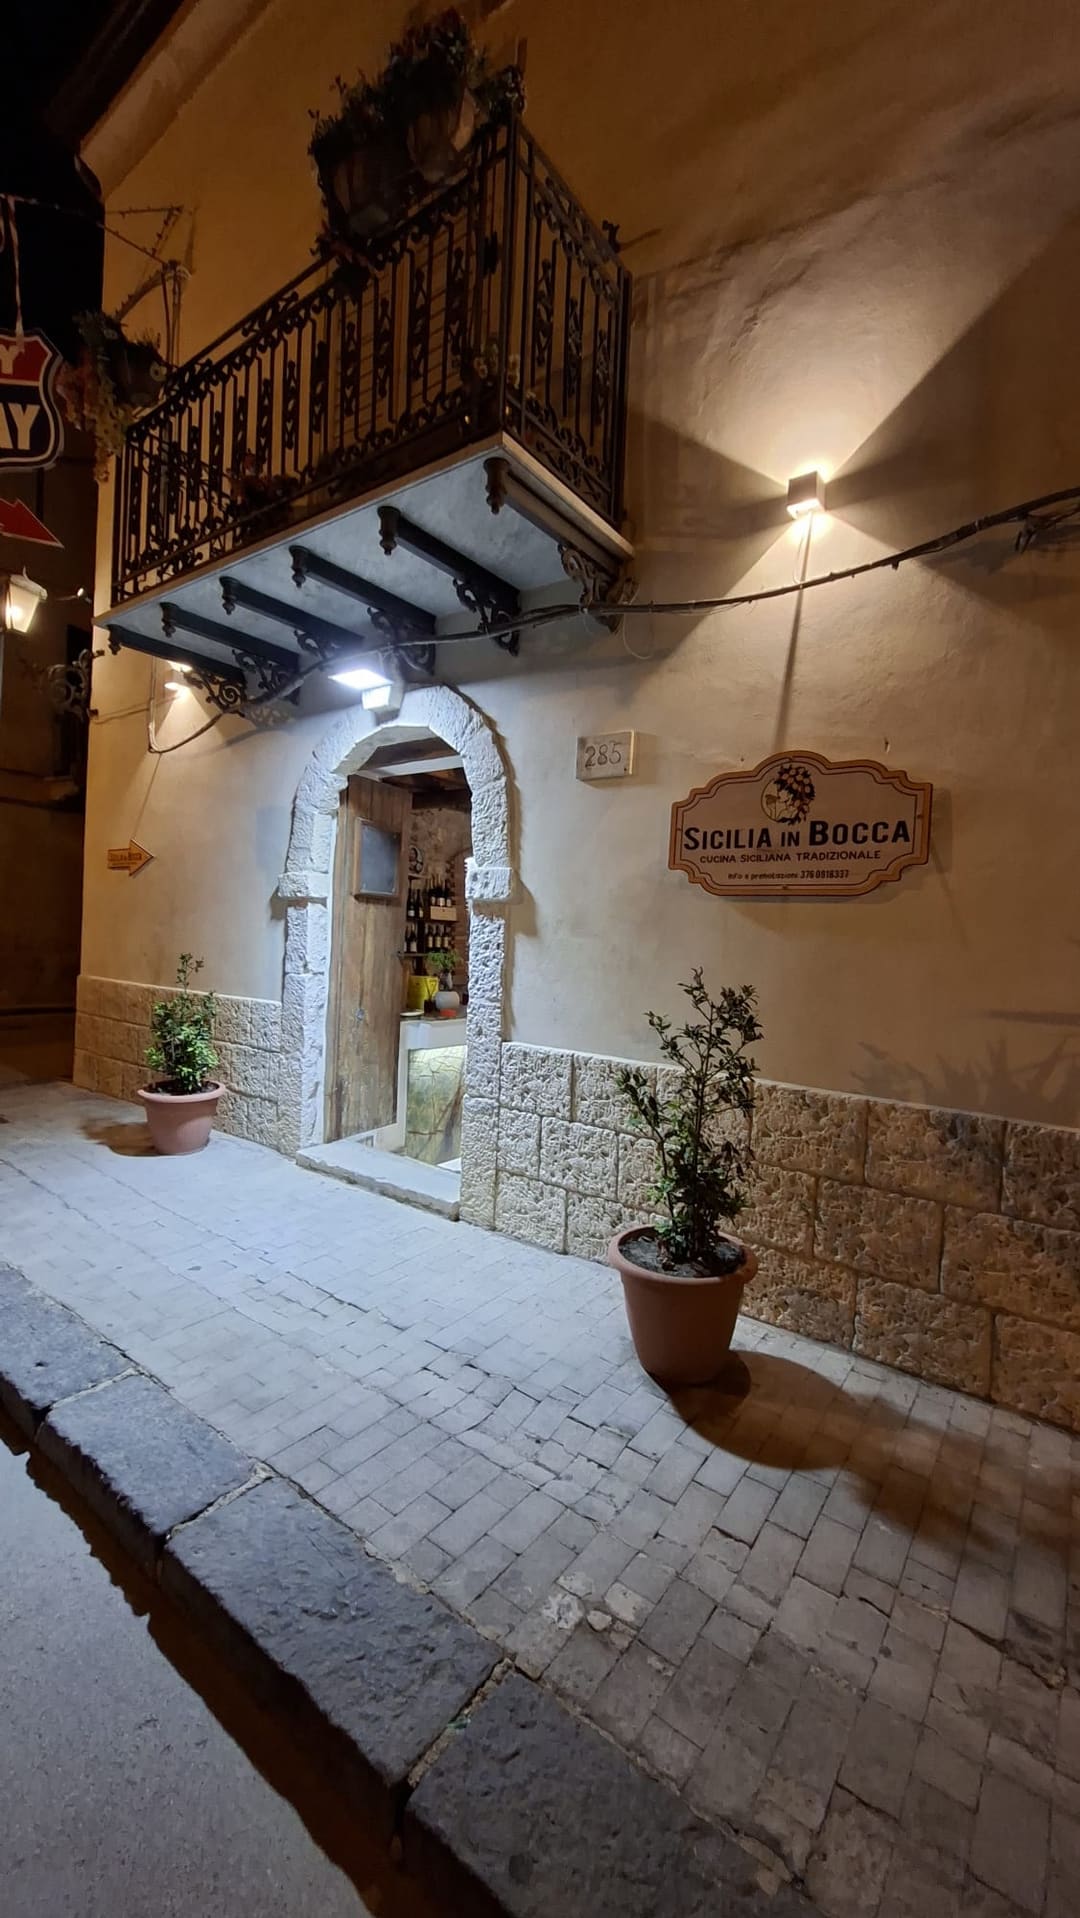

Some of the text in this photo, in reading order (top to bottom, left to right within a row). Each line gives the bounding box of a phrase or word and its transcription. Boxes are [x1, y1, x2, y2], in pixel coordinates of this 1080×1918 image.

[584, 742, 622, 768] 285
[683, 820, 910, 850] SICILIA IN BOCCA
[700, 850, 881, 864] CUCINA SICILIANA TRADIZIONALE
